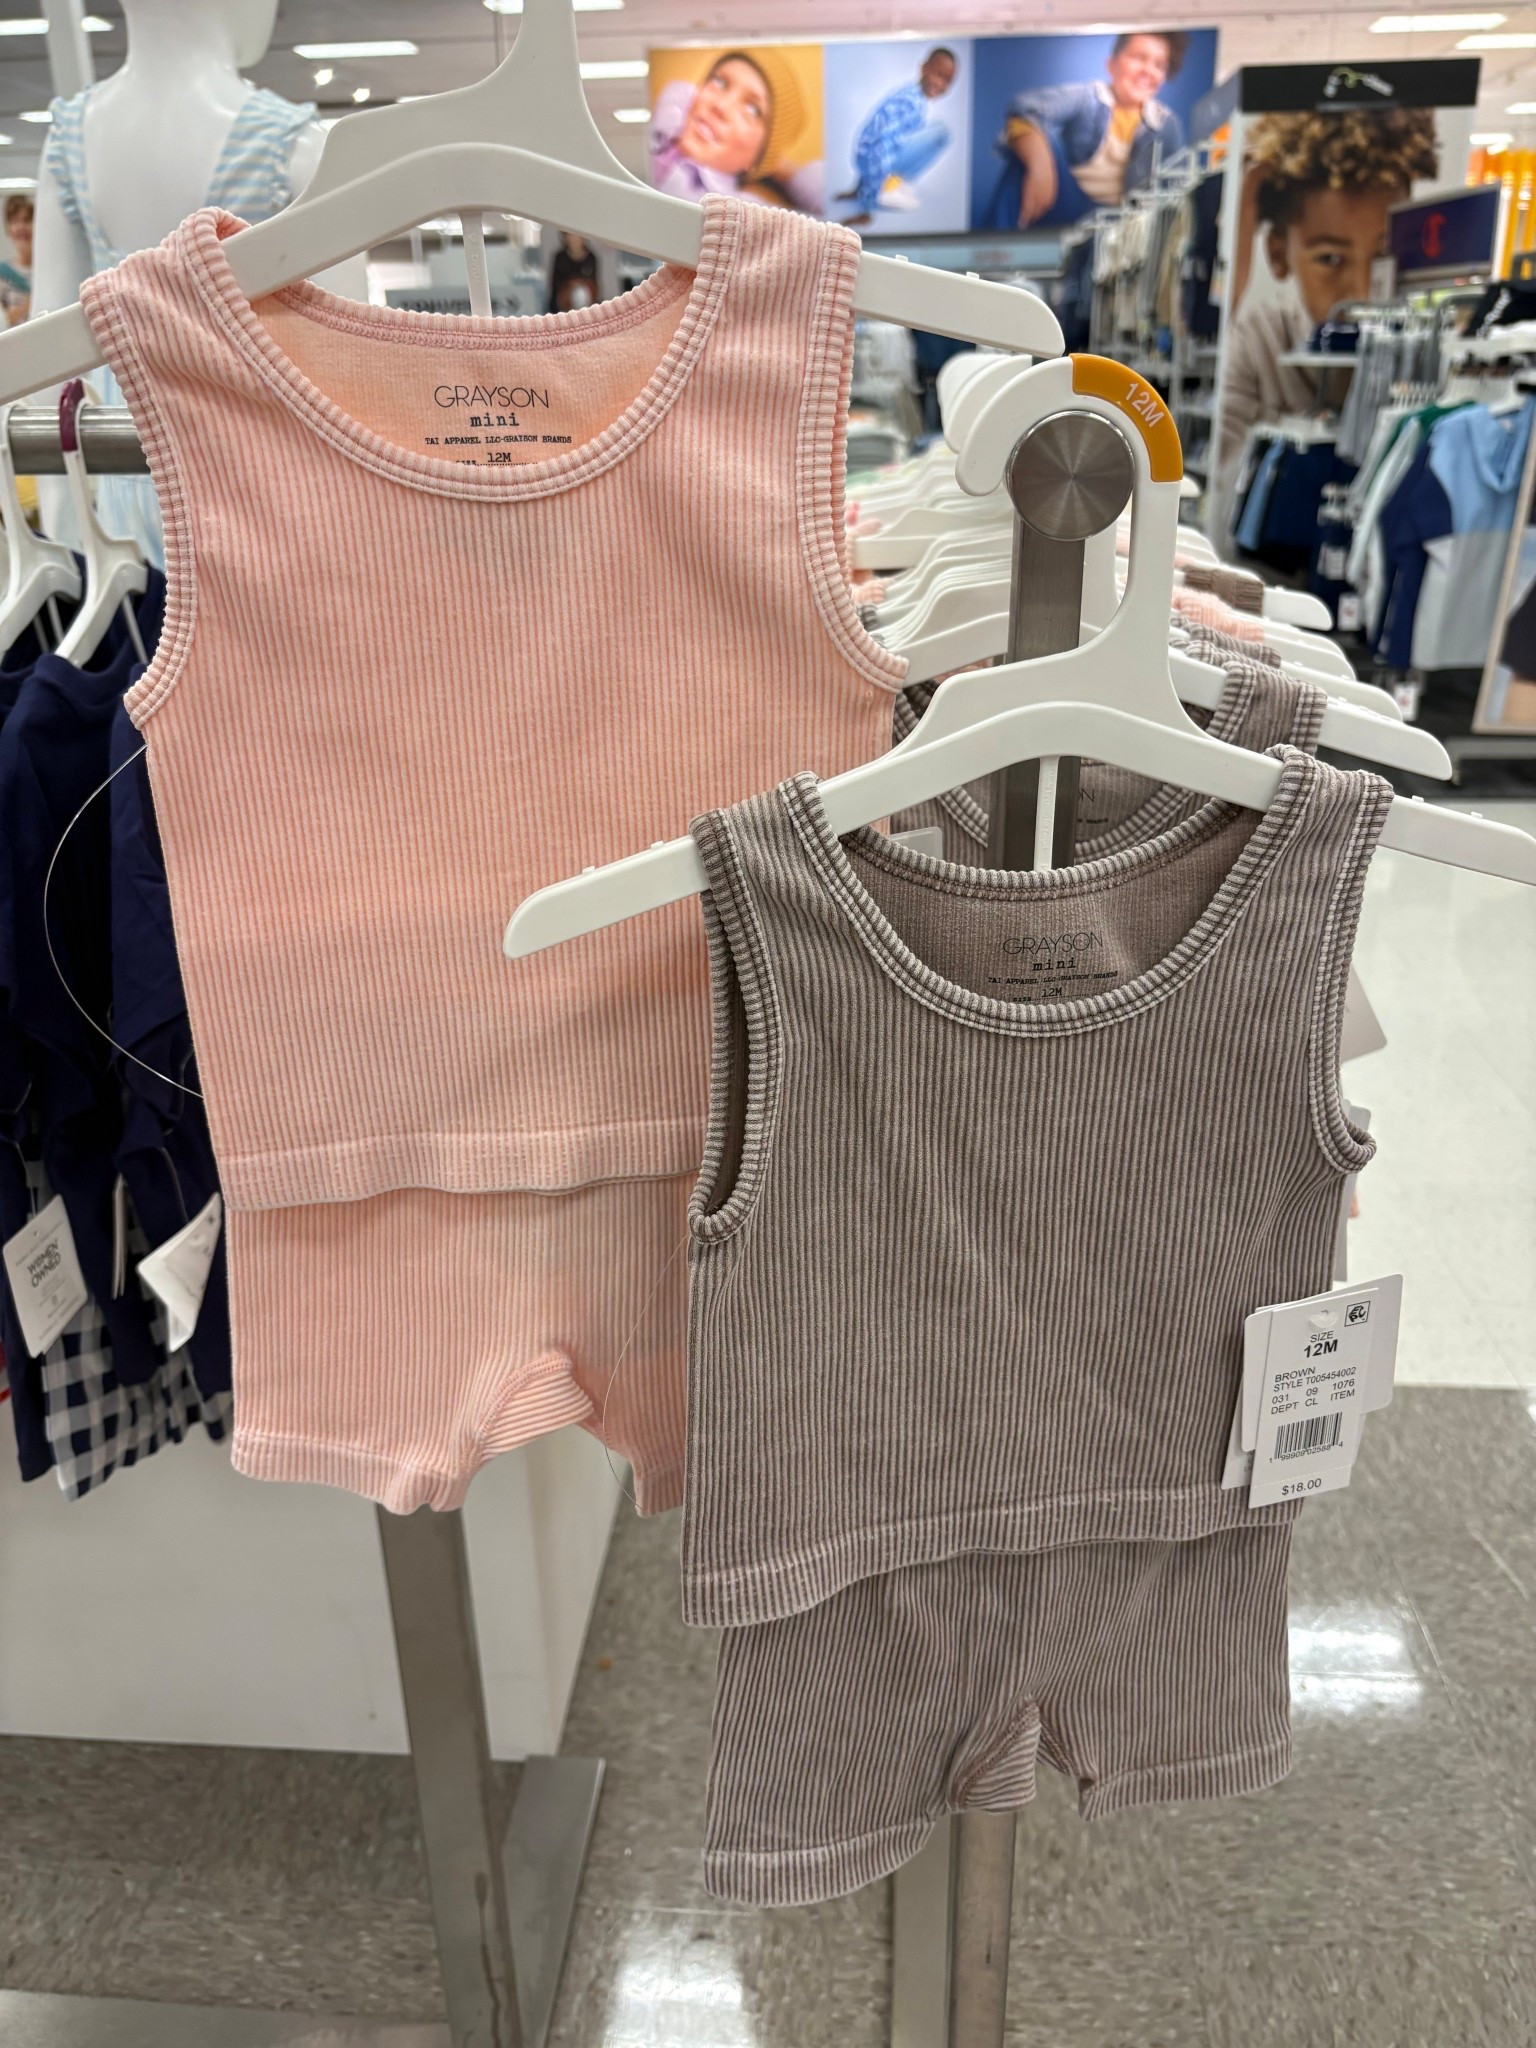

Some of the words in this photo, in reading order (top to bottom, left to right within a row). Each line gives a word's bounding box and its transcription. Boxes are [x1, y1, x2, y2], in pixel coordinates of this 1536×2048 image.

[434, 385, 550, 409] GRAYSON
[1125, 382, 1165, 428] 12M
[470, 412, 520, 427] mini
[425, 437, 439, 445] TAI
[444, 436, 481, 445] APPAREL
[542, 435, 572, 444] BRANDS
[487, 452, 512, 463] 12M
[1003, 931, 1103, 955] GRAYSON
[1032, 957, 1076, 971] mini
[988, 976, 1002, 984] TAI
[1006, 977, 1039, 985] APPAREL
[1041, 987, 1063, 998] 12M
[1310, 1330, 1335, 1344] SIZE
[1304, 1339, 1338, 1358] 12M
[1273, 1378, 1303, 1393] STYLE
[1306, 1366, 1357, 1386] T005454002
[1275, 1366, 1316, 1383] BROWN
[1271, 1393, 1290, 1405] 031
[1306, 1386, 1318, 1397] 09
[1332, 1378, 1355, 1391] 1076
[1271, 1401, 1300, 1415] DEPT
[1305, 1398, 1318, 1408] CL
[1330, 1388, 1355, 1402] ITEM
[1281, 1477, 1322, 1496] $18.00
